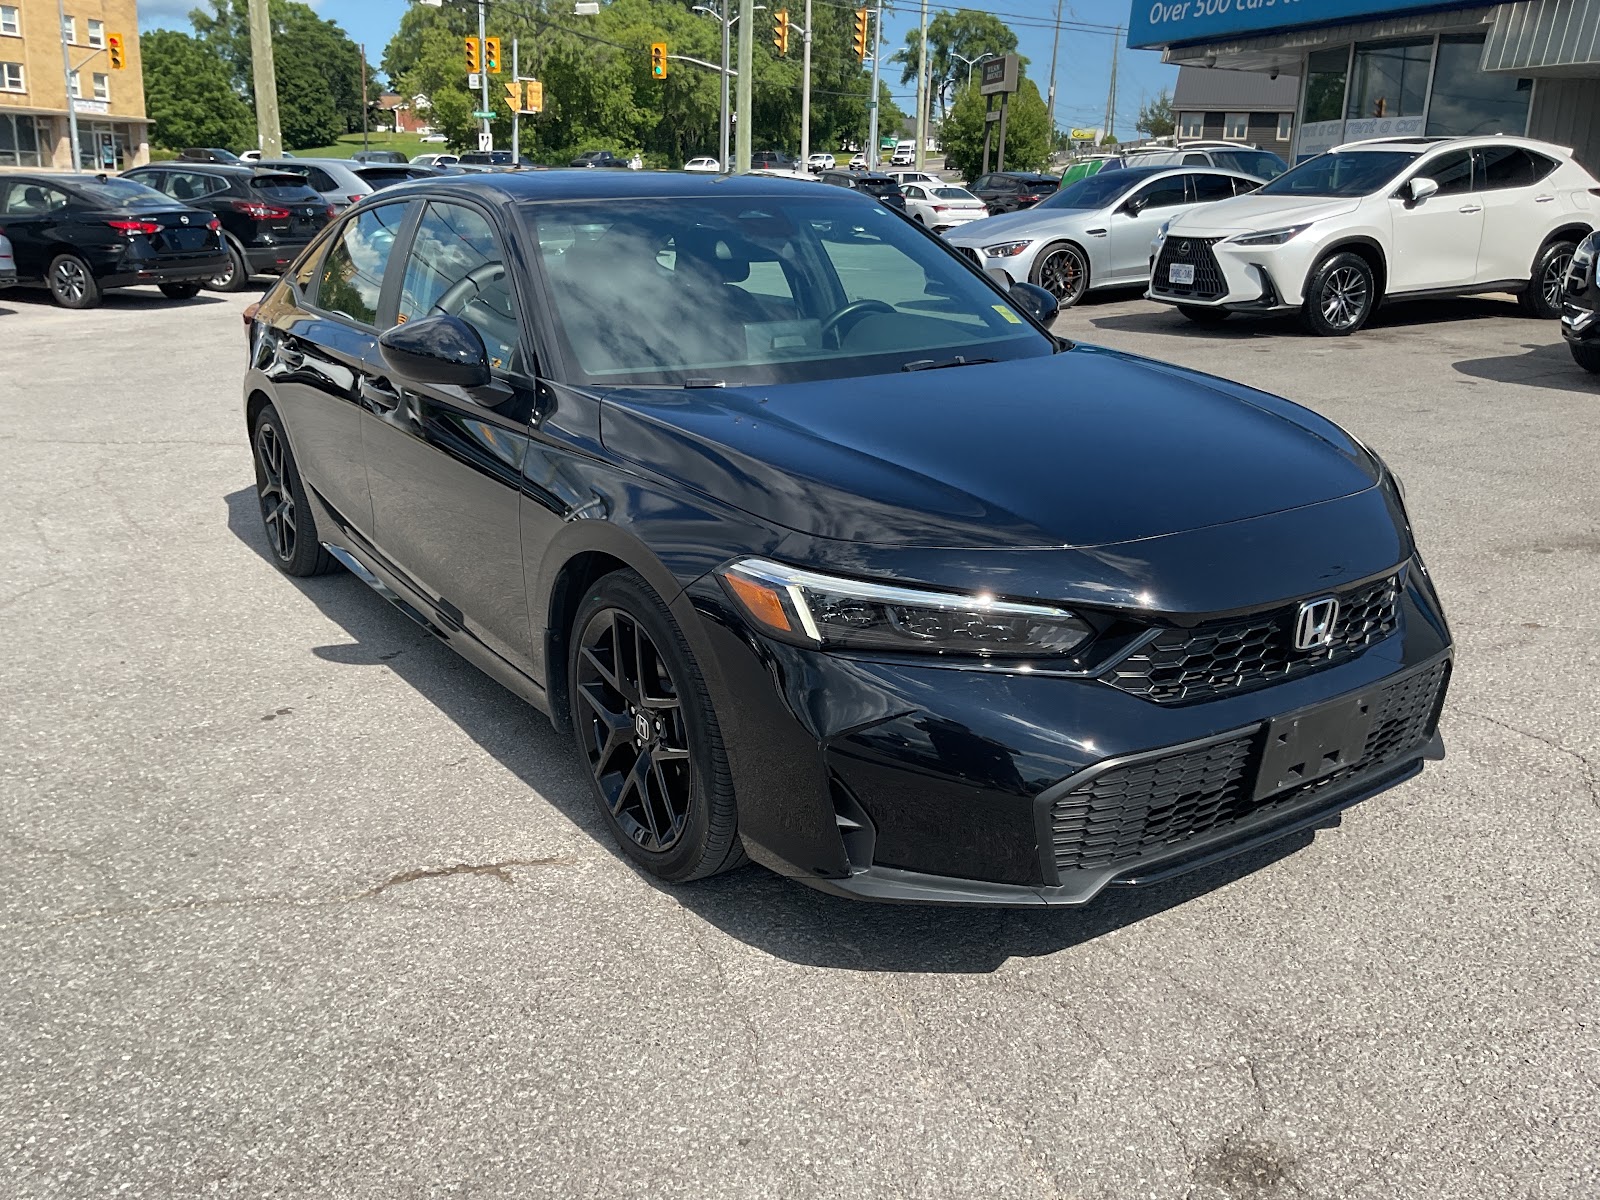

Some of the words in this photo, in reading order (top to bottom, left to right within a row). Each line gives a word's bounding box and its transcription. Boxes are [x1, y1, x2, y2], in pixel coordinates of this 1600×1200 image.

[1150, 2, 1190, 24] Over
[1193, 0, 1230, 17] 500
[1345, 119, 1378, 135] rent
[1380, 120, 1391, 133] a
[1395, 119, 1421, 133] car
